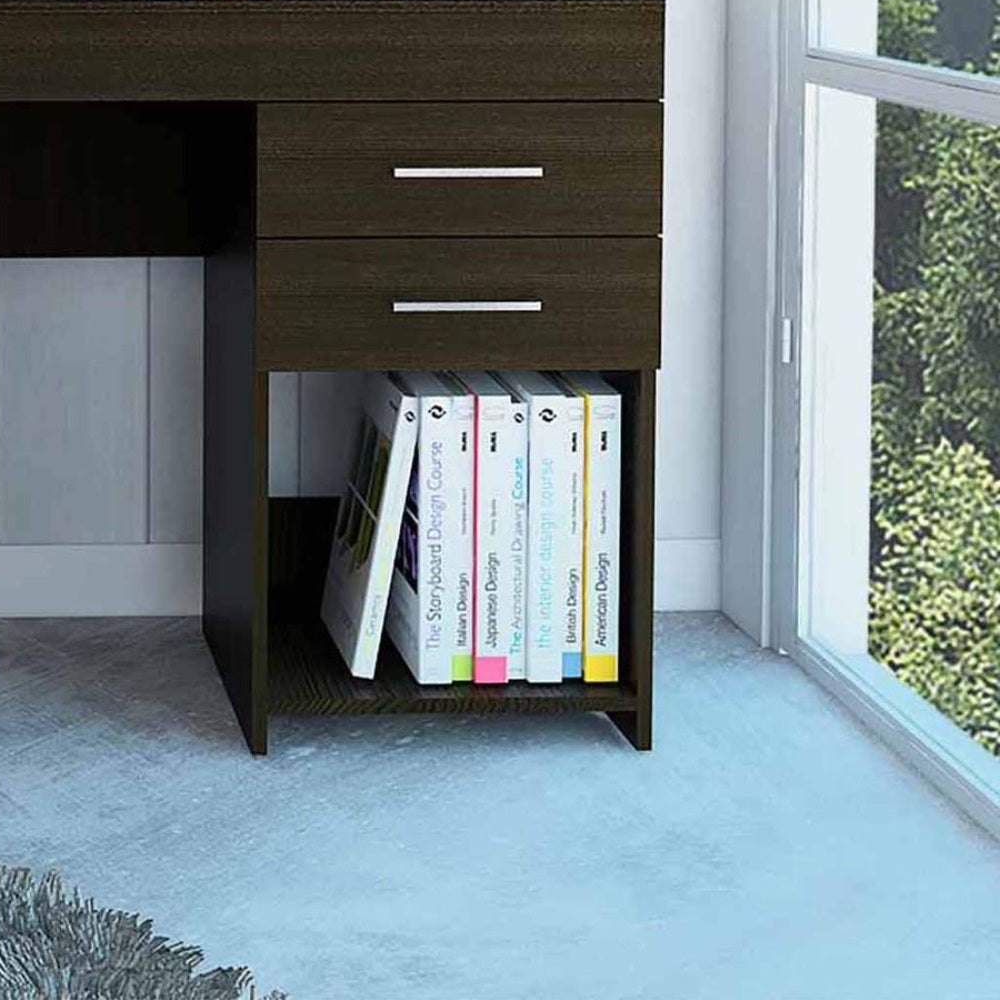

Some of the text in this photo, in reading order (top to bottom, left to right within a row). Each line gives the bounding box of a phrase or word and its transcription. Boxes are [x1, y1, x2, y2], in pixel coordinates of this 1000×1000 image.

[512, 456, 524, 500] Course
[426, 440, 447, 650] The Storyboard Design Course
[511, 502, 526, 551] Drawing
[457, 572, 470, 612] Design
[485, 552, 500, 592] Design
[567, 568, 581, 607] Design
[595, 552, 610, 591] Design
[485, 593, 499, 648] Japanese
[594, 593, 607, 647] American
[510, 632, 523, 654] The
